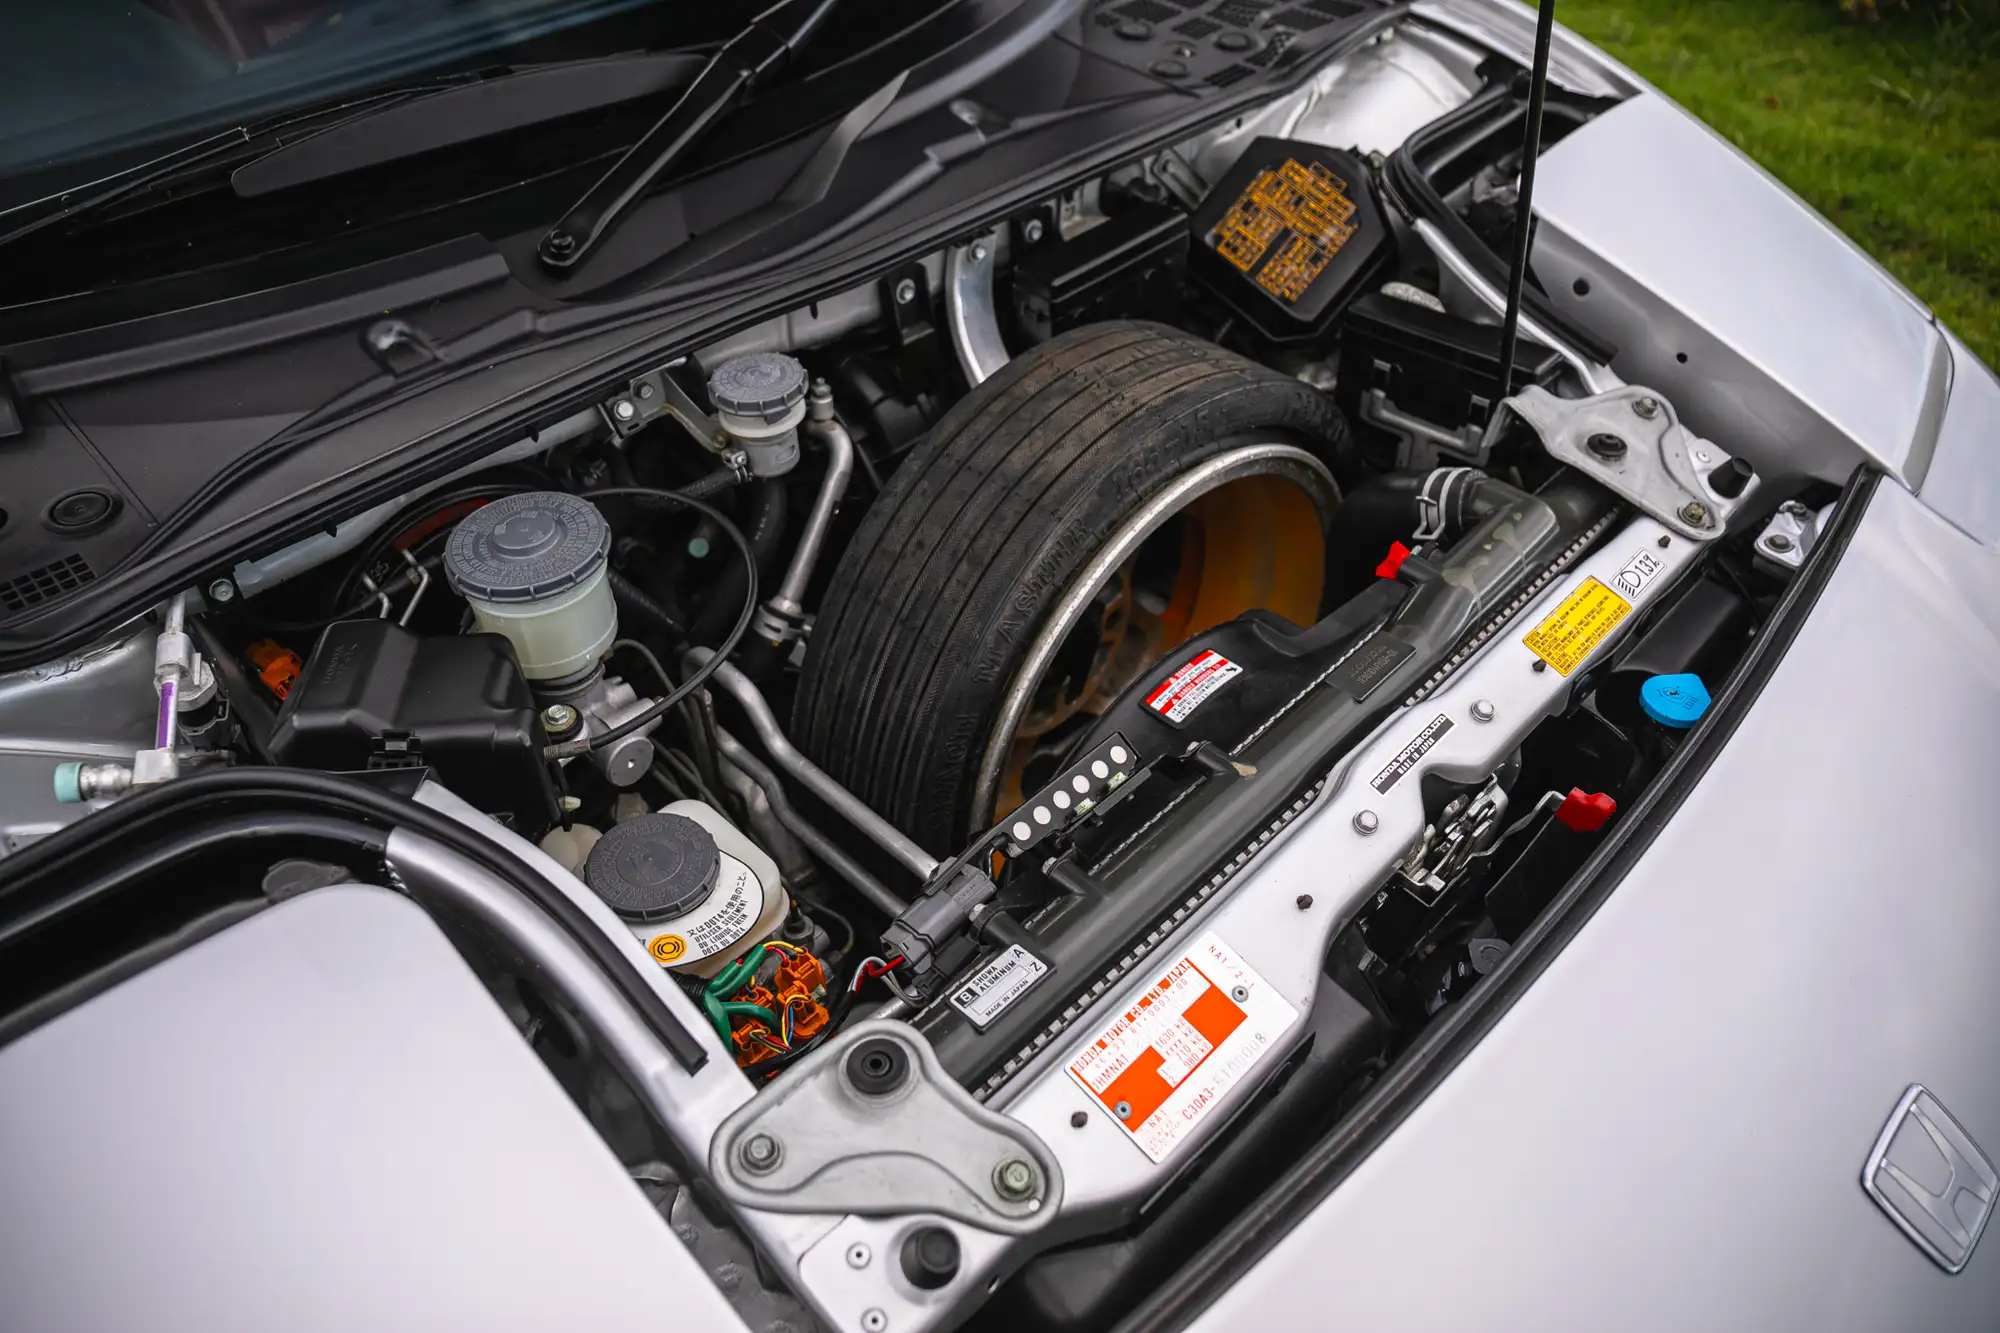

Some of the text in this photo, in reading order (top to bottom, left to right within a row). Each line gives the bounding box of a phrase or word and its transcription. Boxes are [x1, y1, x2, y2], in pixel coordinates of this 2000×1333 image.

[1635, 553, 1660, 577] 1.3%
[1372, 761, 1400, 788] HONDA
[1397, 737, 1424, 764] MOTOR
[1397, 737, 1435, 775] MADE IN JAPAN
[694, 900, 748, 942] UTILISER SEULEMENT
[732, 913, 748, 928] FREIN
[1013, 948, 1025, 959] A
[1029, 961, 1042, 972] Z
[972, 965, 998, 986] SHOWA
[979, 960, 1017, 992] ALUMINUM
[985, 980, 1029, 1017] MADE IN JAPAN
[1072, 1041, 1102, 1073] HONDA
[1102, 1014, 1131, 1047] MOTOR
[1167, 958, 1191, 985] JAPAN
